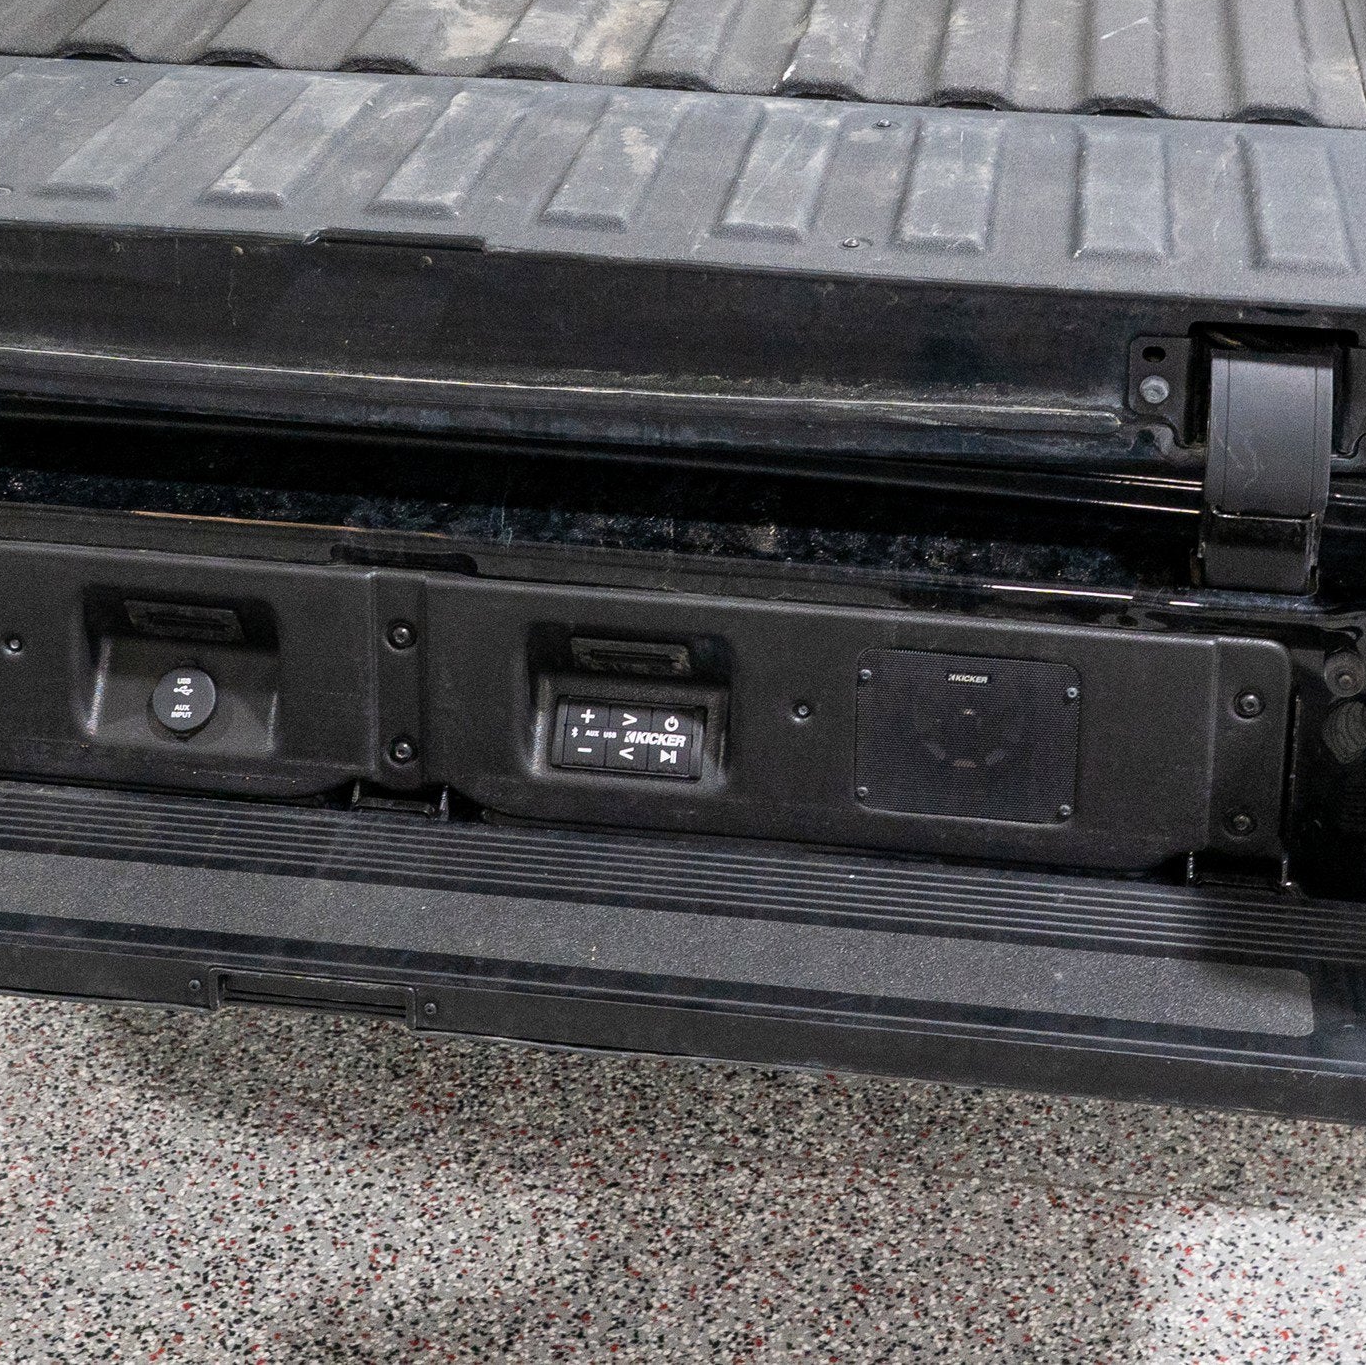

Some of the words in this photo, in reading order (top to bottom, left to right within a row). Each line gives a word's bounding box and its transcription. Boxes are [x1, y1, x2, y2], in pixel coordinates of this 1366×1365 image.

[176, 677, 192, 685] USB
[955, 674, 989, 684] KICKER
[585, 729, 600, 737] AUX
[603, 731, 617, 739] USB
[635, 731, 687, 748] KICKER
